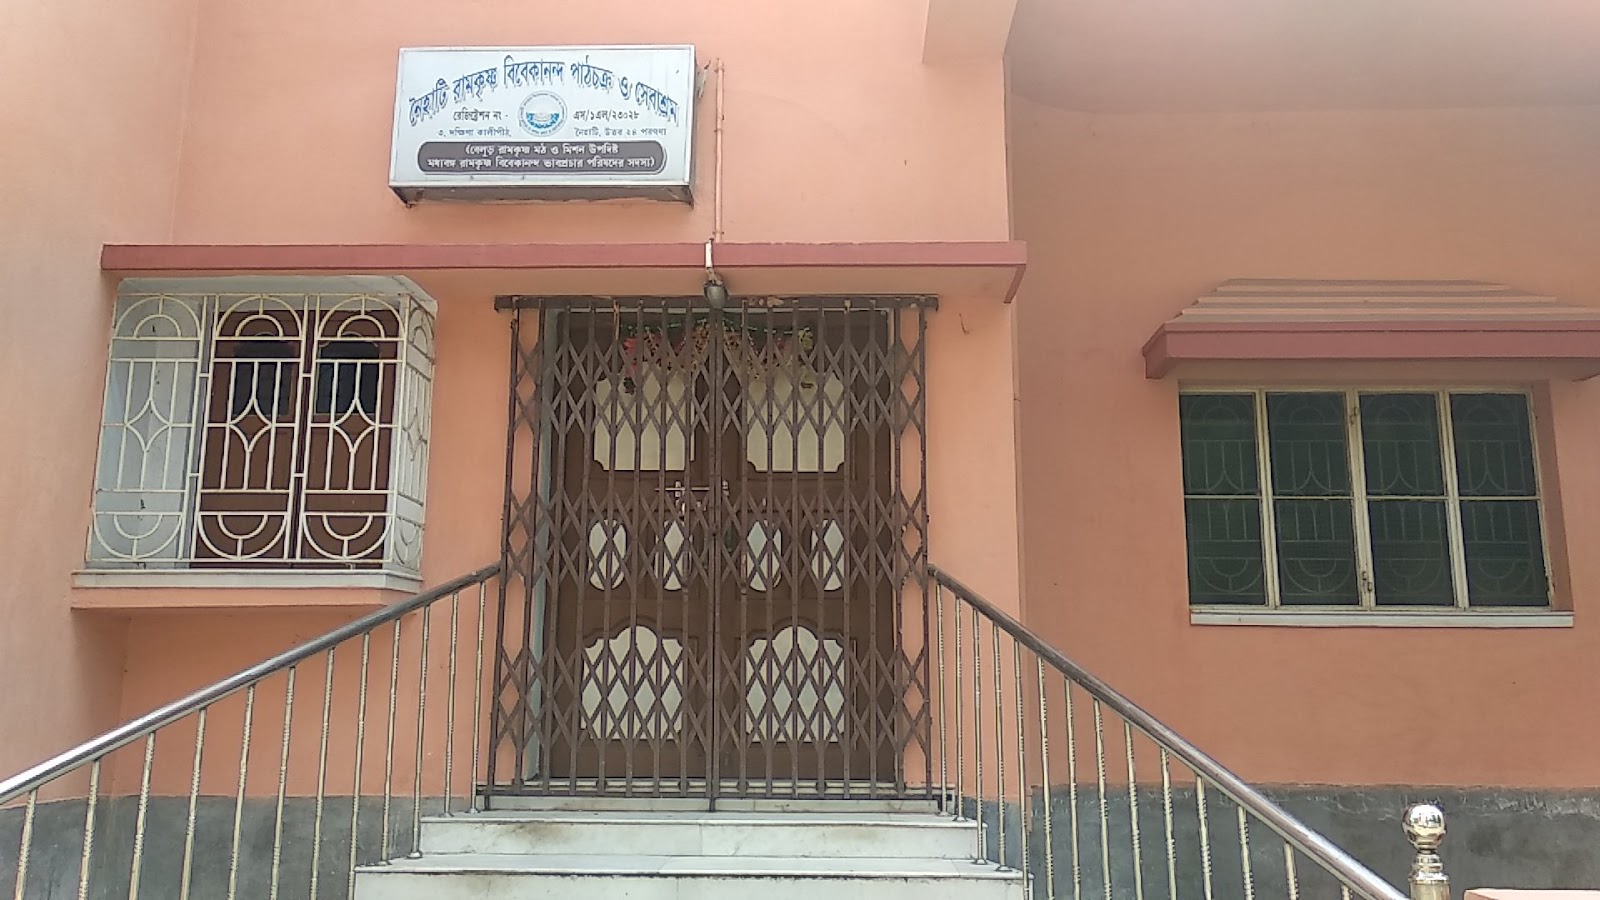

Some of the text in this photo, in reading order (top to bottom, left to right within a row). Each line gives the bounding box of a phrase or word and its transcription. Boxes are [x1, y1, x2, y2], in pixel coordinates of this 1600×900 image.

[409, 55, 679, 127] নৈহাটি রামকৃষ্ণ বিবেকানন্দ পাঠচক্র ও সেবাশ্রম
[550, 145, 559, 155] ও
[562, 143, 585, 155] মিশন
[459, 158, 492, 170] রামকৃষ্ণ
[495, 155, 540, 168] বিবেকানন্দ
